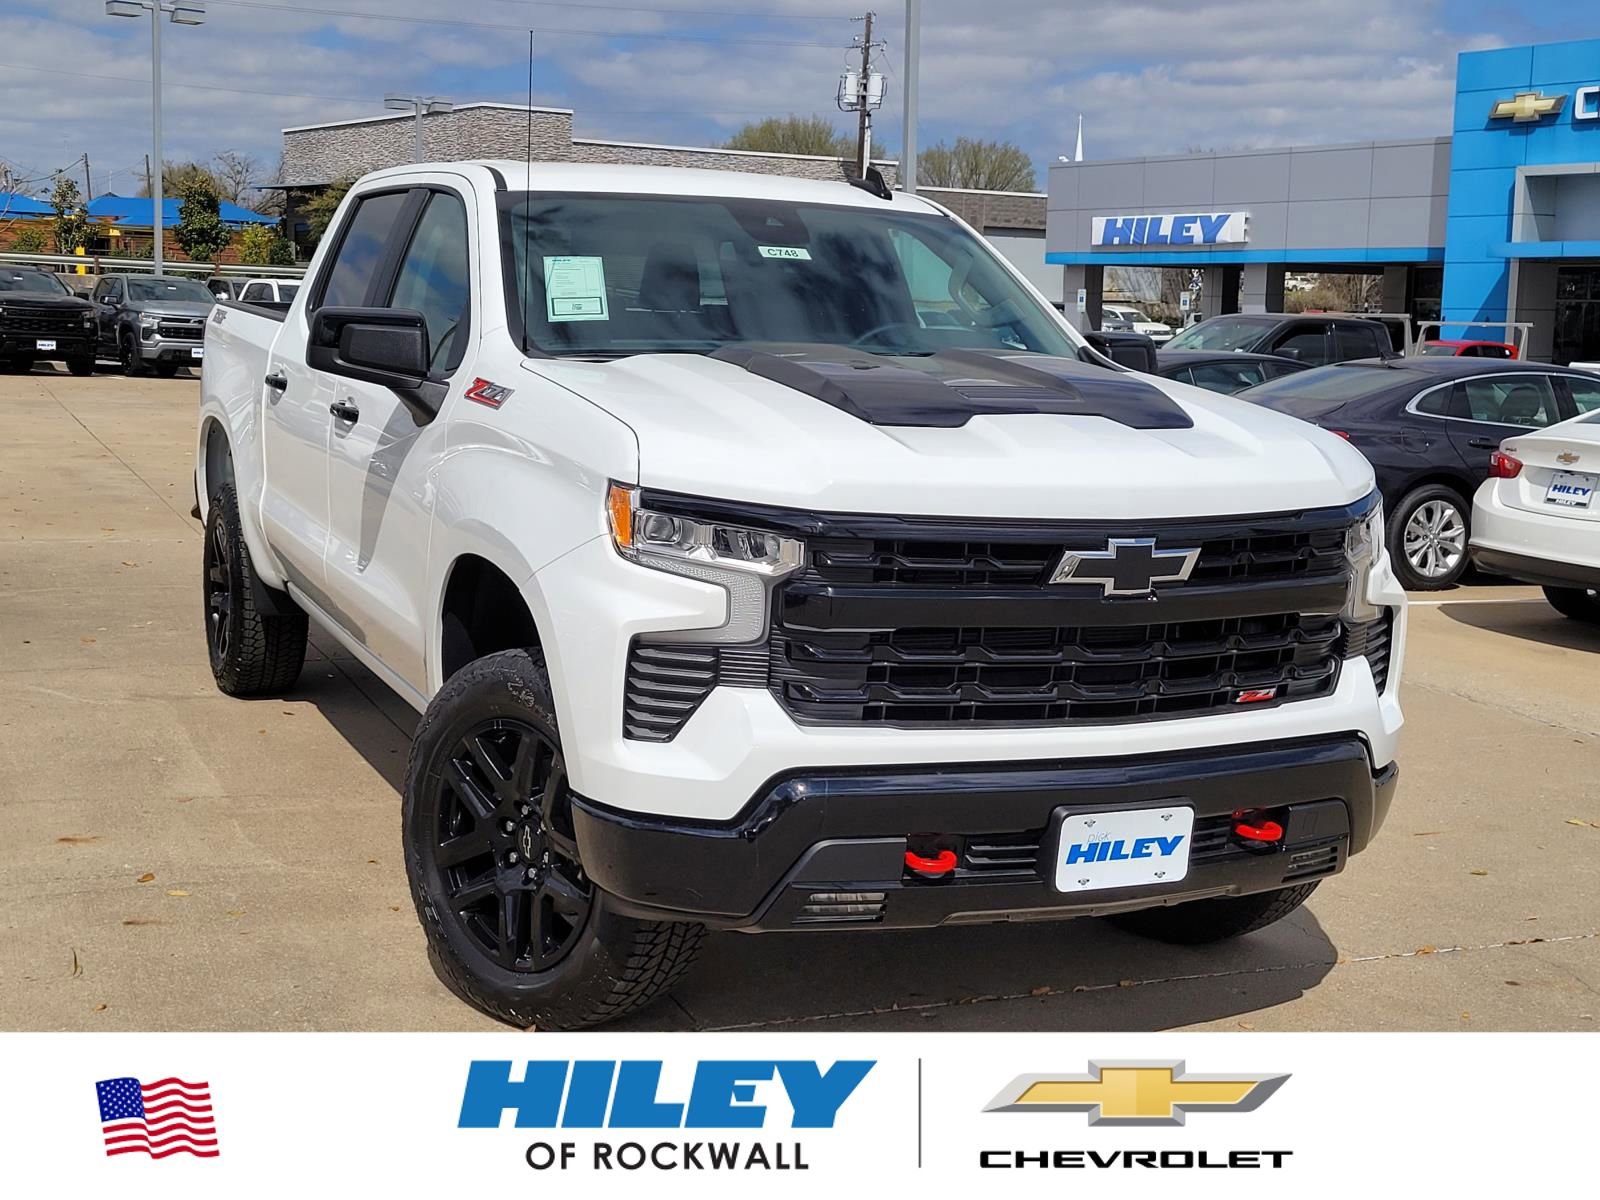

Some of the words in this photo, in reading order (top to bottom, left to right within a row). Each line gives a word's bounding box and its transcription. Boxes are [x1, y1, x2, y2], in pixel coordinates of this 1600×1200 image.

[1102, 214, 1231, 245] HILEY
[767, 248, 799, 258] C748
[1552, 484, 1591, 496] HILEY
[1065, 835, 1185, 865] HILEY
